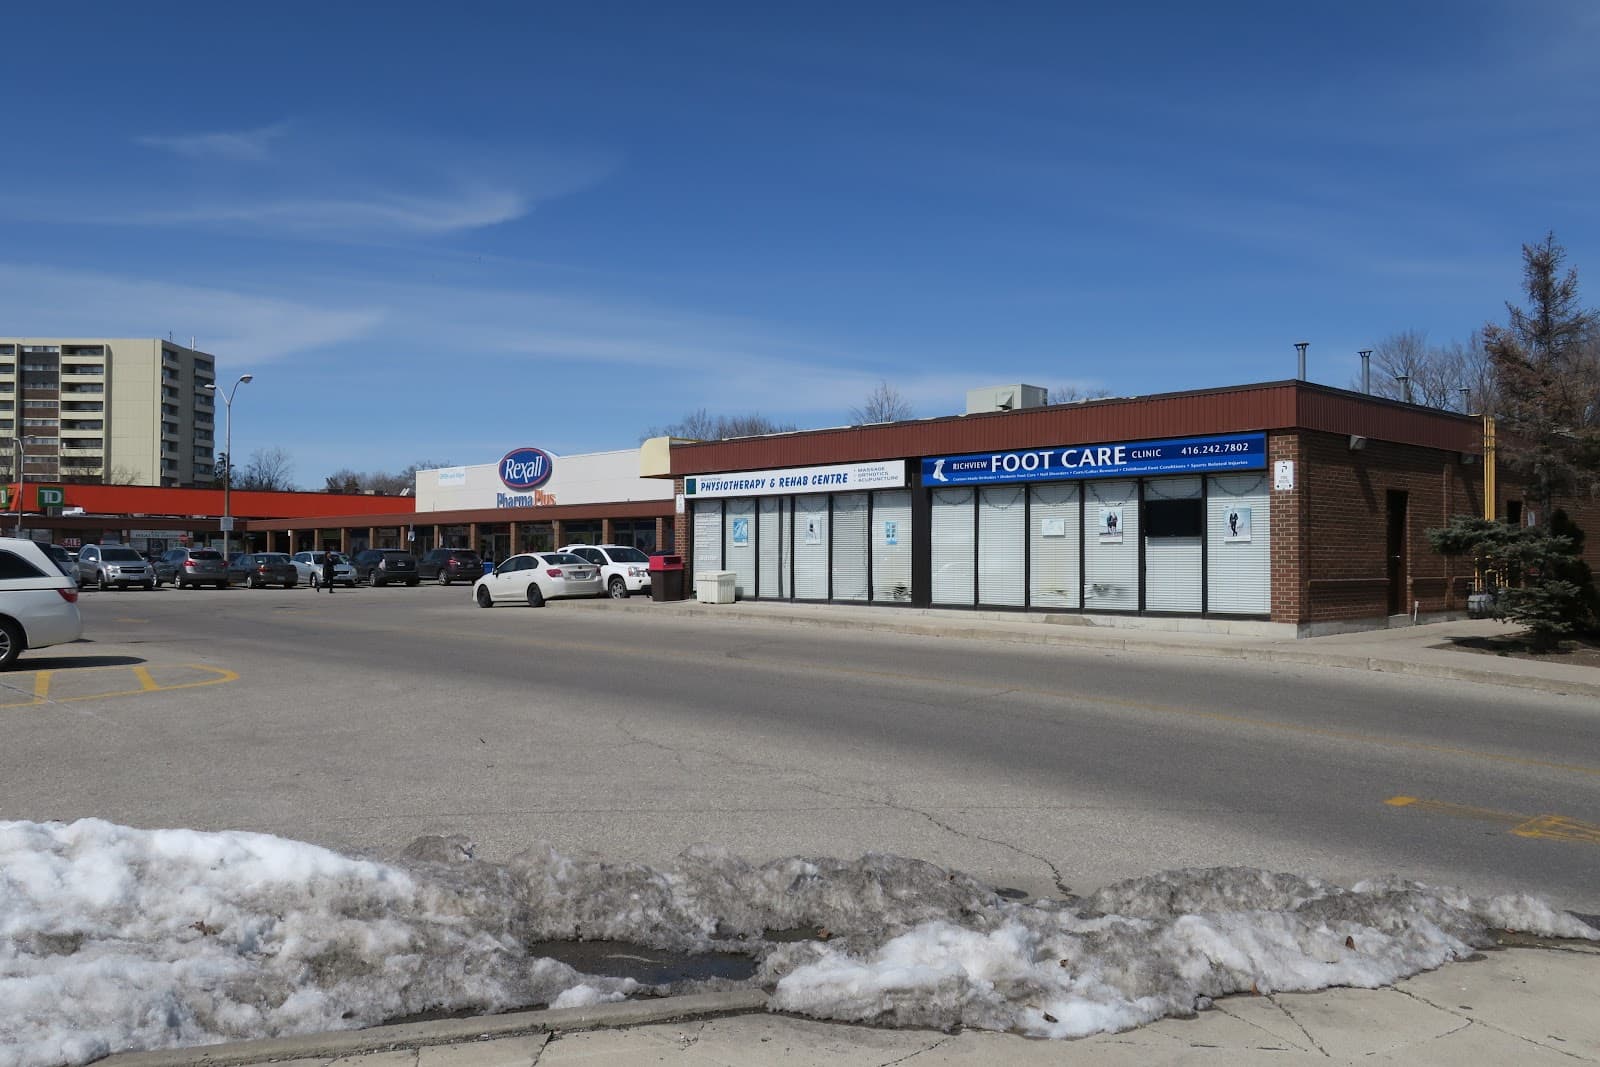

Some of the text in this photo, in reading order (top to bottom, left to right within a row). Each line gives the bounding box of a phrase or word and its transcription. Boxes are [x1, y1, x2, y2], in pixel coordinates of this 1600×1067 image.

[1181, 442, 1249, 455] 416.242.7802
[952, 446, 1162, 473] RICHVIEW FOOT CARE CLINIC
[505, 456, 543, 483] Rexall
[700, 472, 848, 492] PHYSIOTHERAPY & REHAB CENTRE
[39, 489, 62, 504] TD
[496, 489, 557, 508] Pharma Plus
